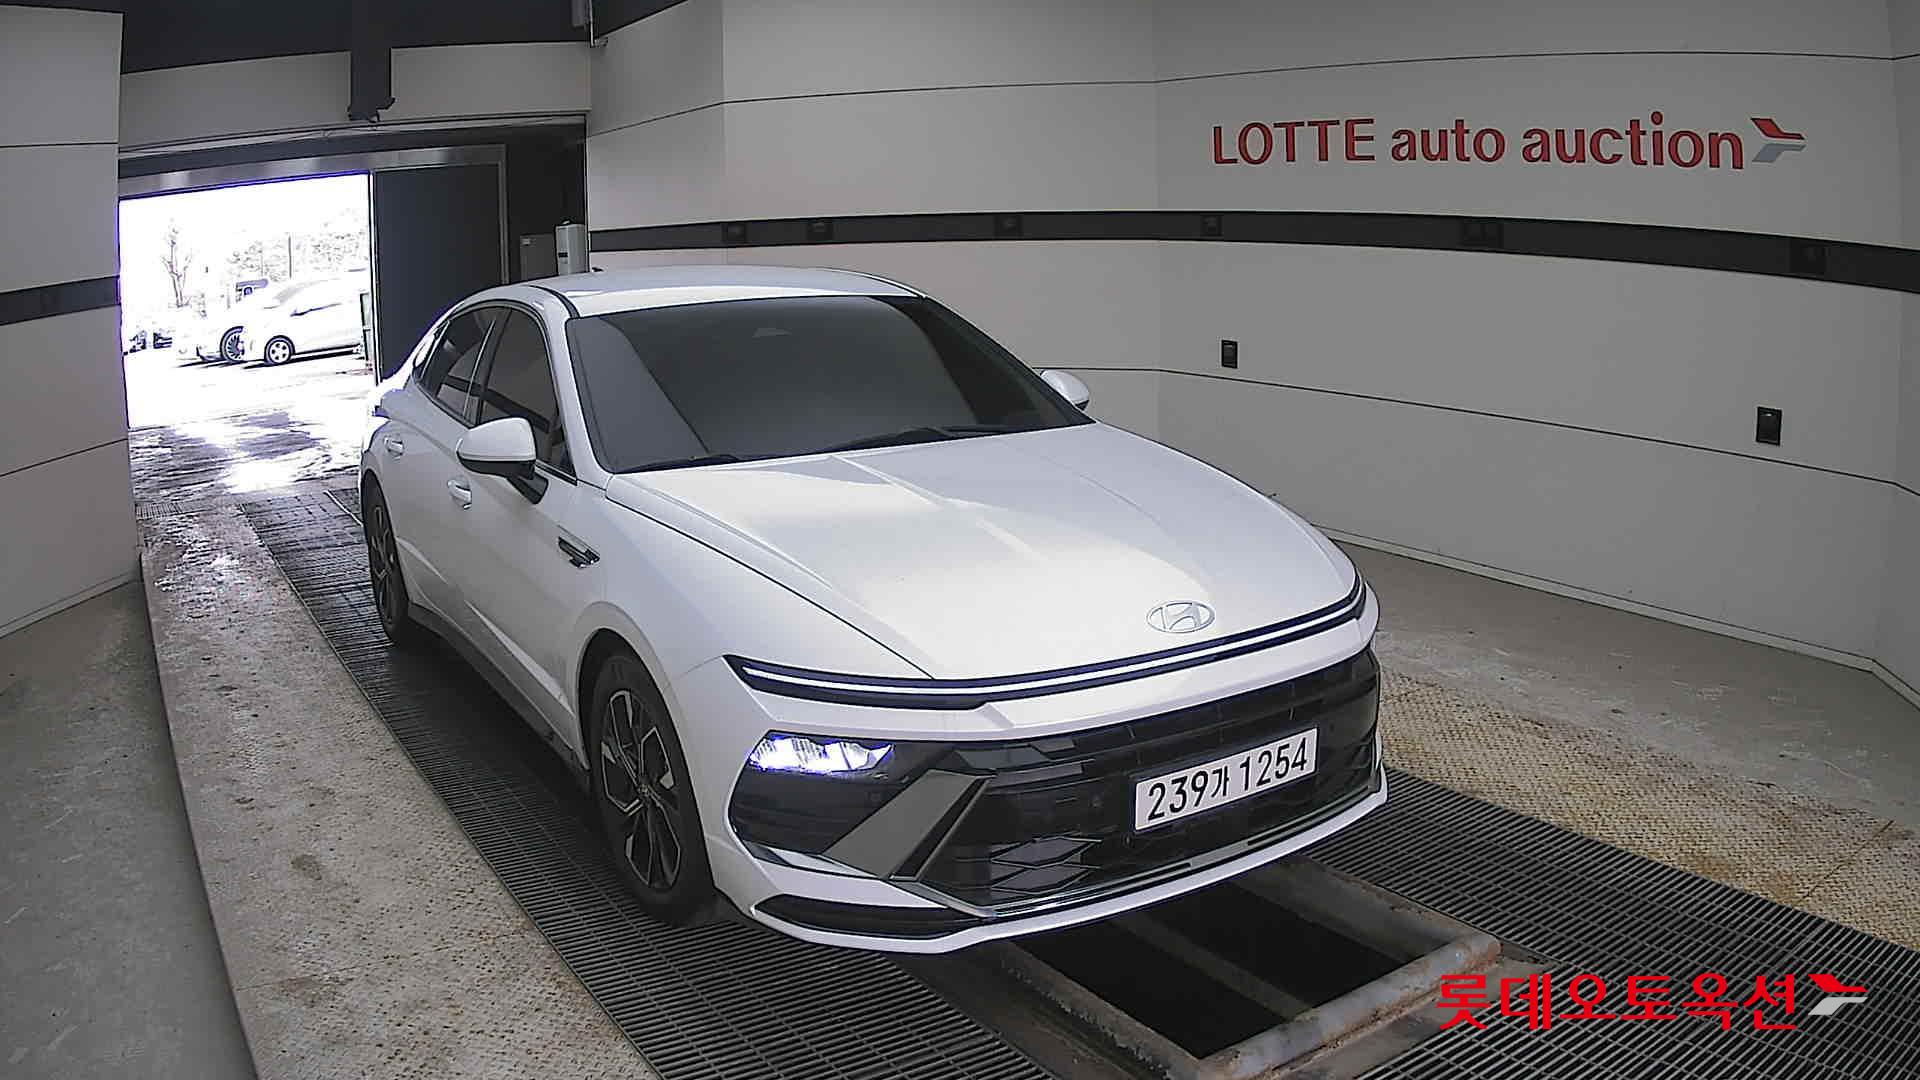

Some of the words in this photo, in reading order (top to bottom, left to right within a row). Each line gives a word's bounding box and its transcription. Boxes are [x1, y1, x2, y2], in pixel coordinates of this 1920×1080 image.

[1212, 118, 1376, 164] LOTTE
[1391, 119, 1506, 163] auto
[1521, 111, 1745, 170] auction
[1147, 765, 1230, 820] 239가
[1240, 737, 1308, 791] 1254
